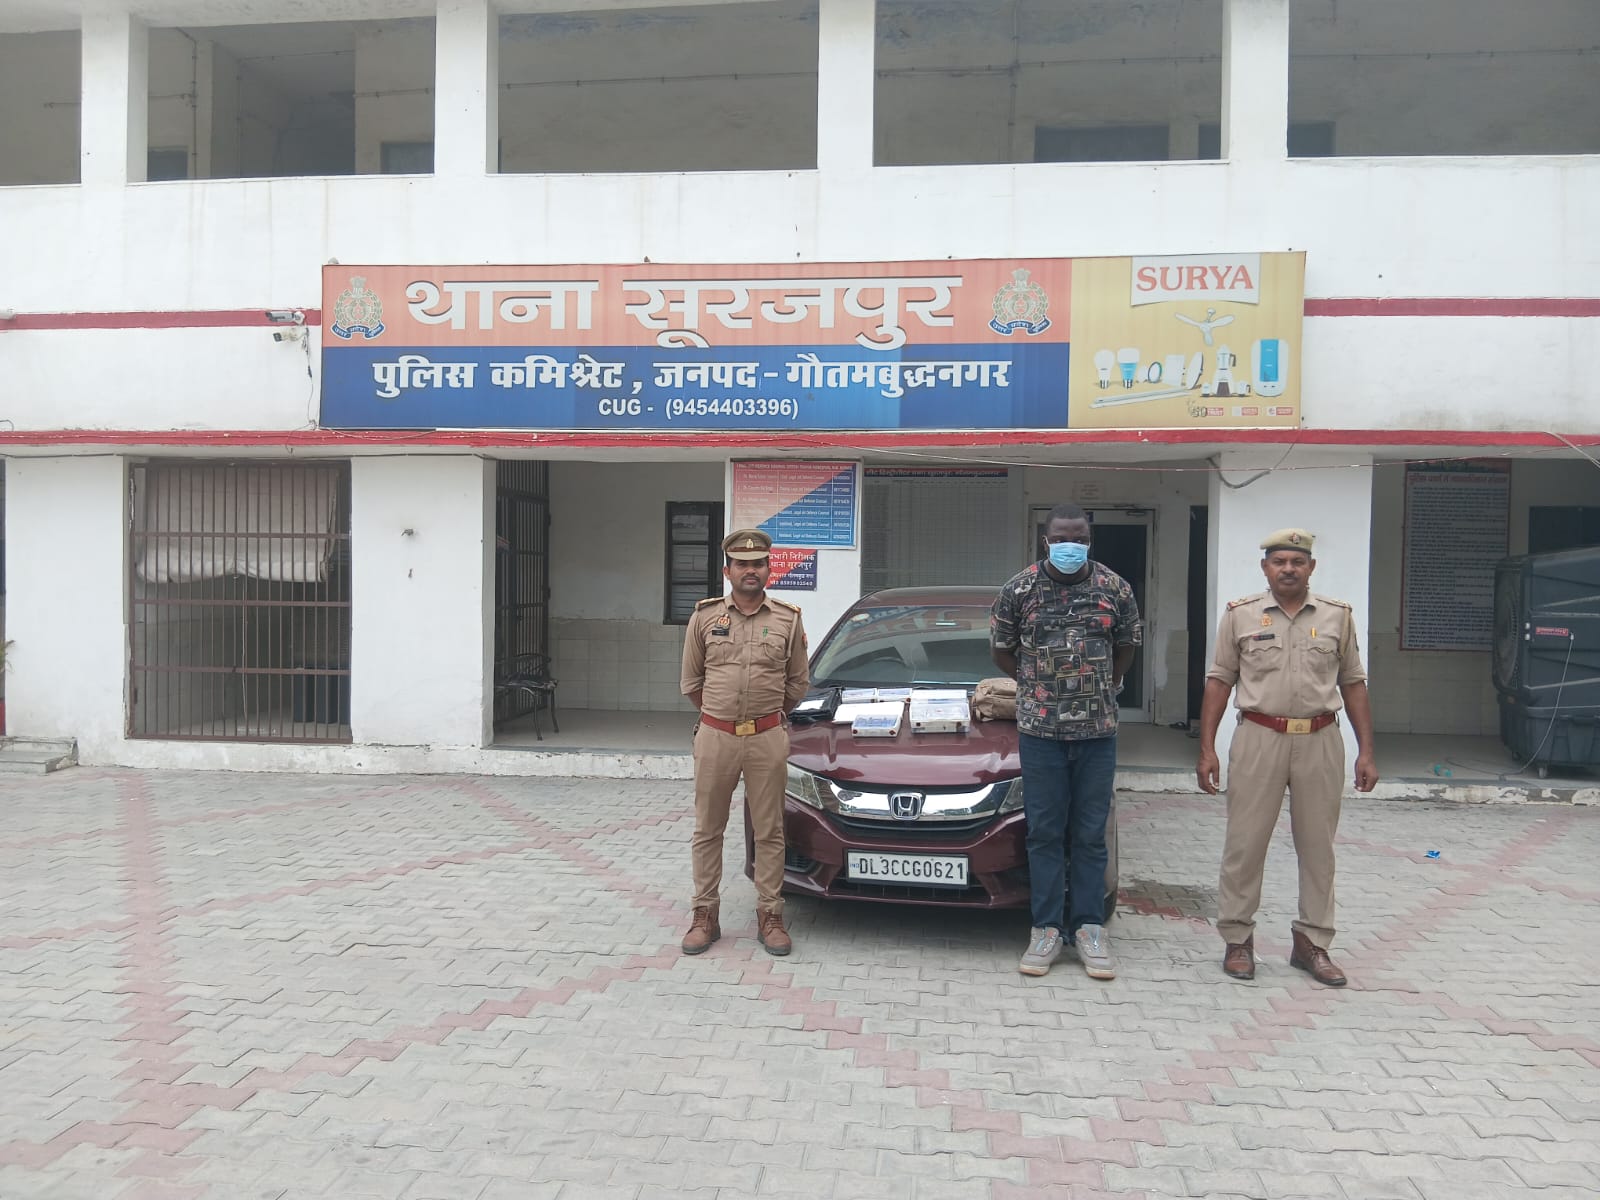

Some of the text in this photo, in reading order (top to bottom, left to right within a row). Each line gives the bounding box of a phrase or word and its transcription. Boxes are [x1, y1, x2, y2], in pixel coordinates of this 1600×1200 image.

[1136, 265, 1253, 291] SURYA
[405, 275, 963, 351] थाना सूरजपुर
[372, 354, 479, 398] पुलिस
[653, 362, 760, 388] जनपद
[598, 399, 641, 416] CUG
[665, 398, 799, 420] (9454403396)
[859, 858, 963, 880] DL3CCG0621
